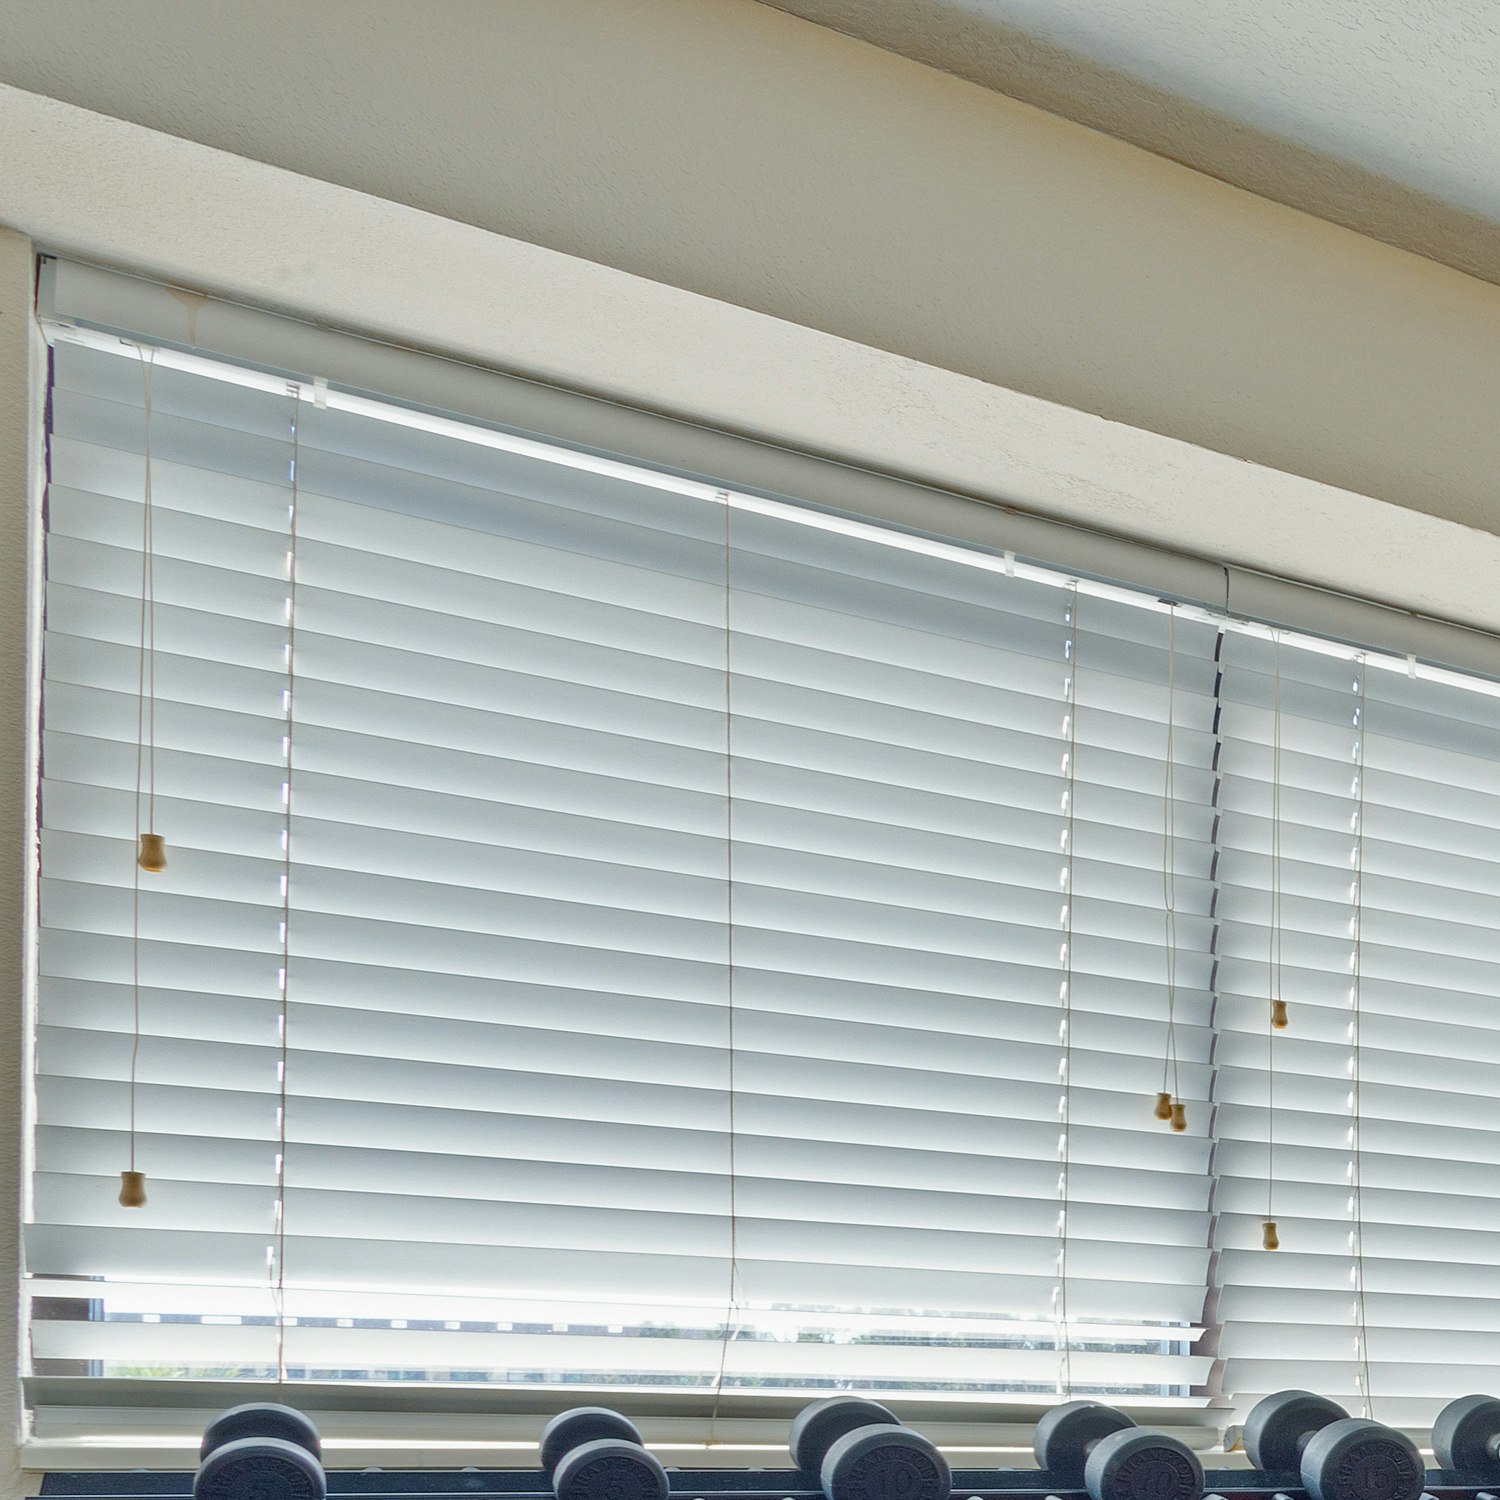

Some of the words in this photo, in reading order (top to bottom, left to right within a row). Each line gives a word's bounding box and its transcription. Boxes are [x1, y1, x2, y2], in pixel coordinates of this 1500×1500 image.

[604, 1477, 624, 1500] 5
[878, 1469, 911, 1495] 10
[1139, 1468, 1172, 1496] 10
[1362, 1466, 1390, 1490] 15
